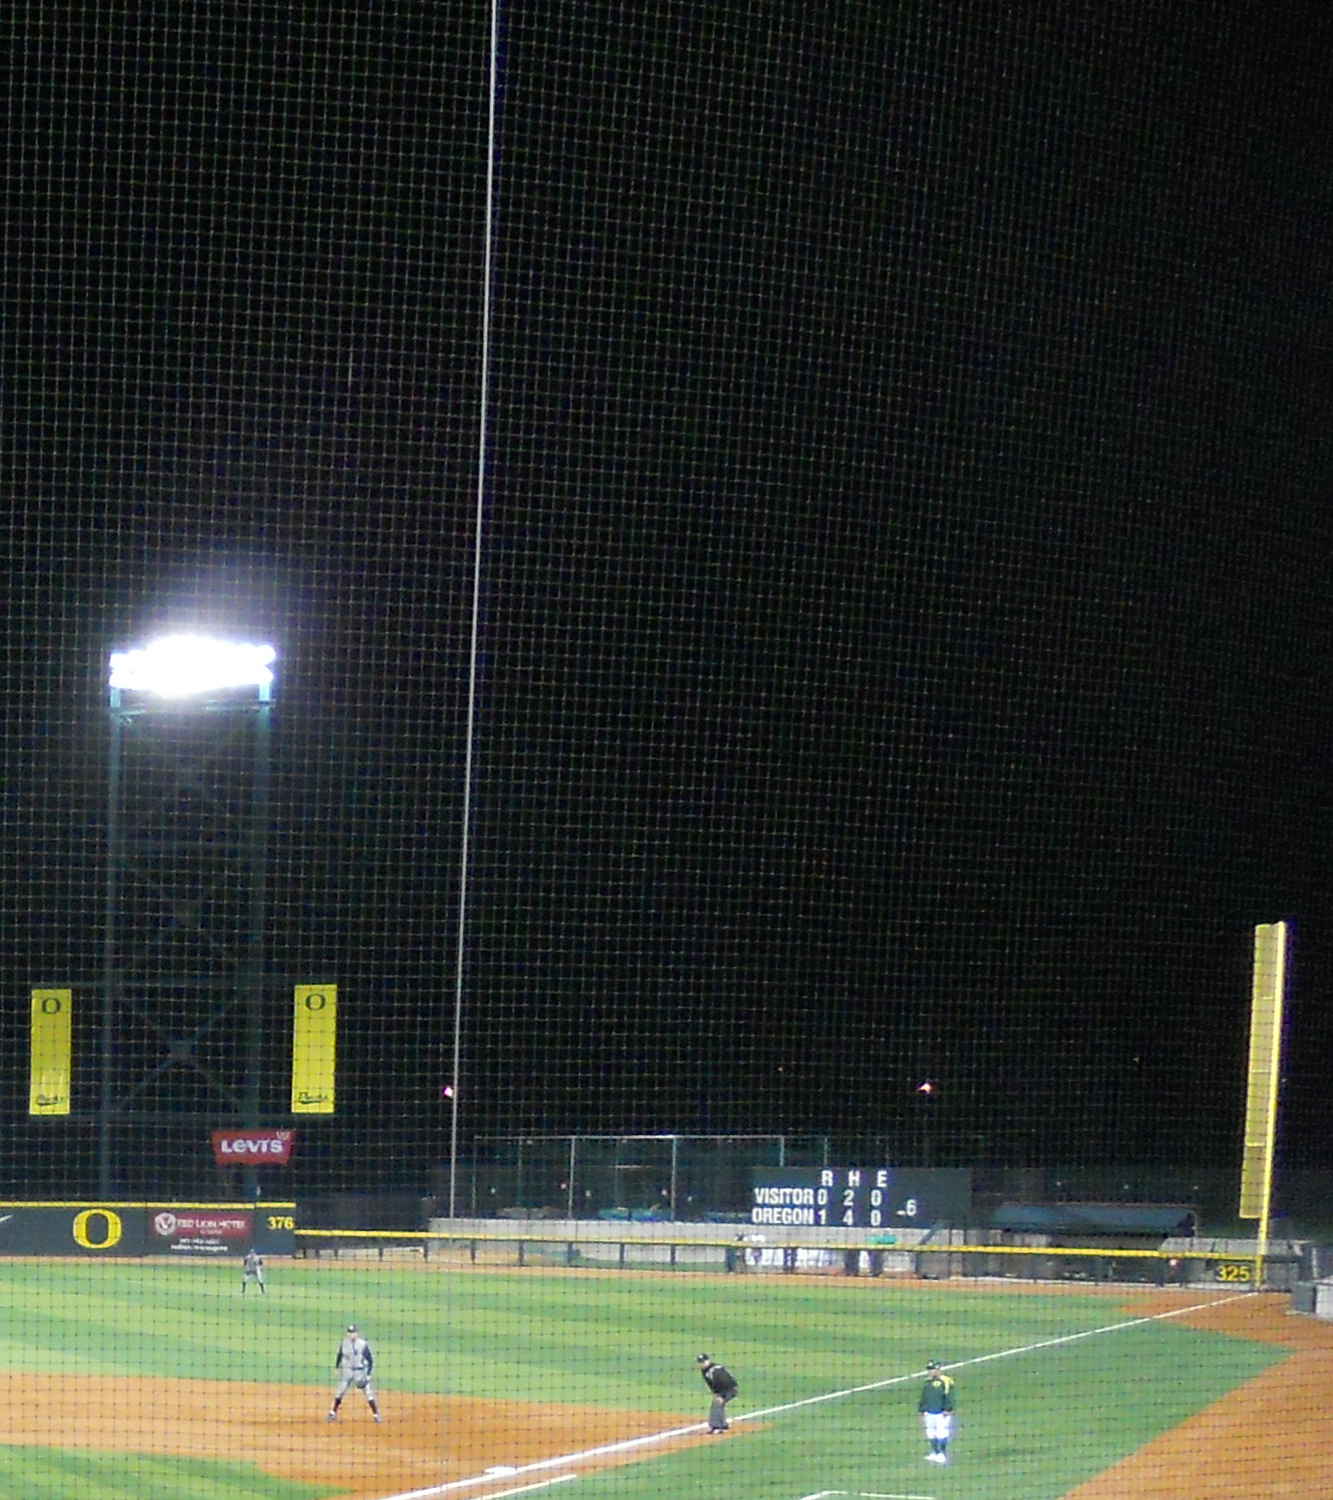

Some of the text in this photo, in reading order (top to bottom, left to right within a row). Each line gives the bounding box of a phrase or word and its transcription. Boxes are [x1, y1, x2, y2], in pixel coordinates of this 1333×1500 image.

[41, 998, 61, 1014] O
[305, 993, 326, 1010] O
[821, 1170, 888, 1187] R H E
[754, 1188, 882, 1206] VISITOR 0 2 0
[219, 1220, 245, 1229] HOTEL
[267, 1216, 294, 1230] 376
[752, 1207, 881, 1226] OREGON 1 4 0
[72, 1209, 122, 1249] O
[1216, 1265, 1251, 1282] 325
